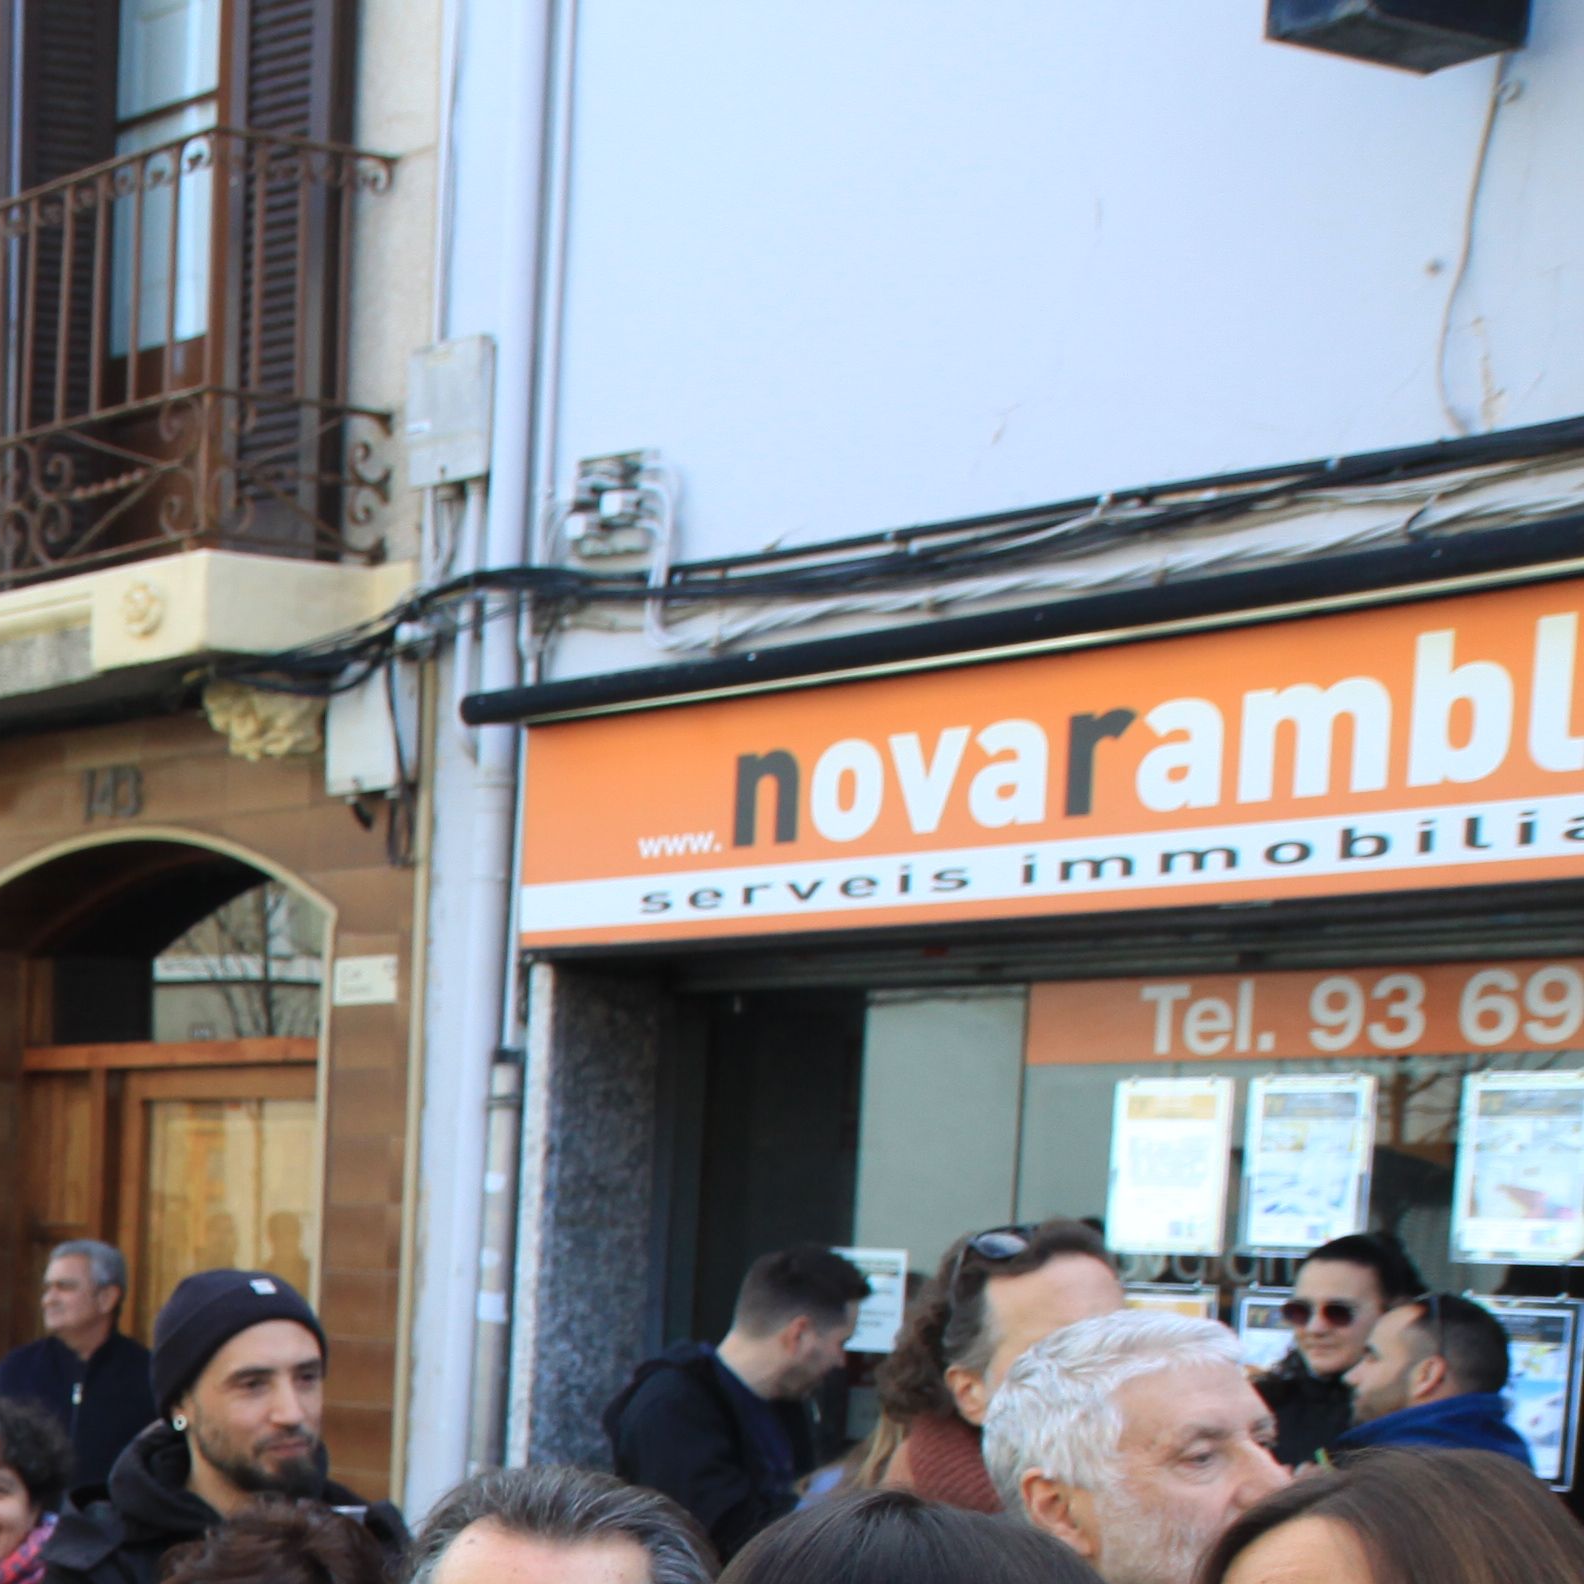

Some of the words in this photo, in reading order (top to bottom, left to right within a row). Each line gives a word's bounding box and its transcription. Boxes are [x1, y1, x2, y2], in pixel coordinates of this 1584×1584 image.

[639, 864, 972, 915] serveis
[1140, 979, 1275, 1057] Tel.
[1308, 974, 1427, 1053] 93
[1458, 966, 1584, 1048] 69
